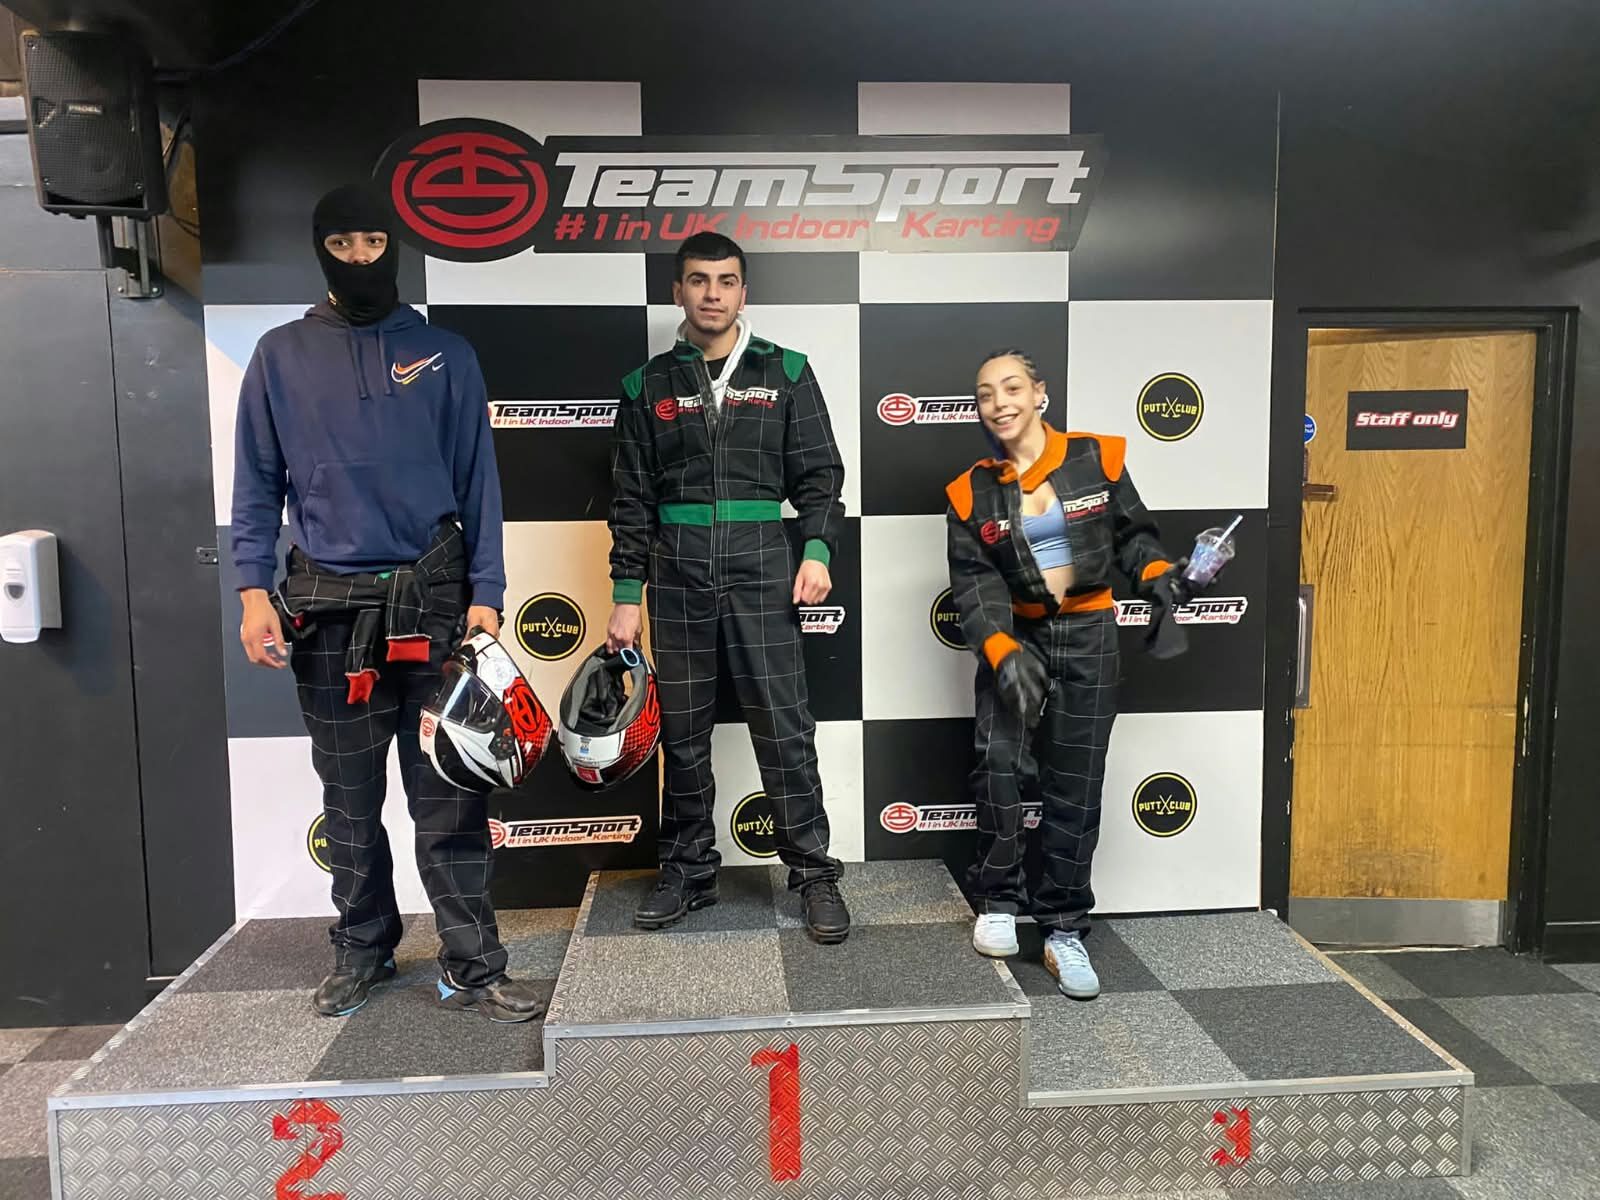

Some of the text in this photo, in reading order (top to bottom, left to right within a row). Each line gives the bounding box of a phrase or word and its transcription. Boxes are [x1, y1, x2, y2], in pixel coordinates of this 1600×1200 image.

[555, 150, 1090, 222] TeamSport
[614, 213, 652, 241] in
[659, 211, 729, 241] UK
[733, 212, 870, 240] Indoor
[902, 210, 1060, 243] Karting
[494, 403, 620, 421] TeamSpor
[1143, 402, 1198, 415] PUTT CLUB
[581, 417, 615, 425] Kartin
[941, 413, 957, 421] UK
[959, 412, 980, 421] Indo
[1355, 410, 1460, 429] Staff only
[937, 612, 960, 622] PUTT
[1200, 613, 1238, 621] Karting
[522, 622, 579, 635] PUTT CLUB
[1138, 801, 1191, 812] PUTT CLUB
[508, 817, 640, 837] TeamSport
[737, 821, 760, 832] PUTT
[942, 820, 958, 829] UK
[314, 838, 328, 848] PU
[533, 836, 551, 844] UK
[551, 834, 586, 843] Indoor
[592, 832, 632, 841] Karting
[751, 1042, 802, 1182] 1
[1211, 1104, 1252, 1168] 3
[272, 1098, 346, 1200] 2
